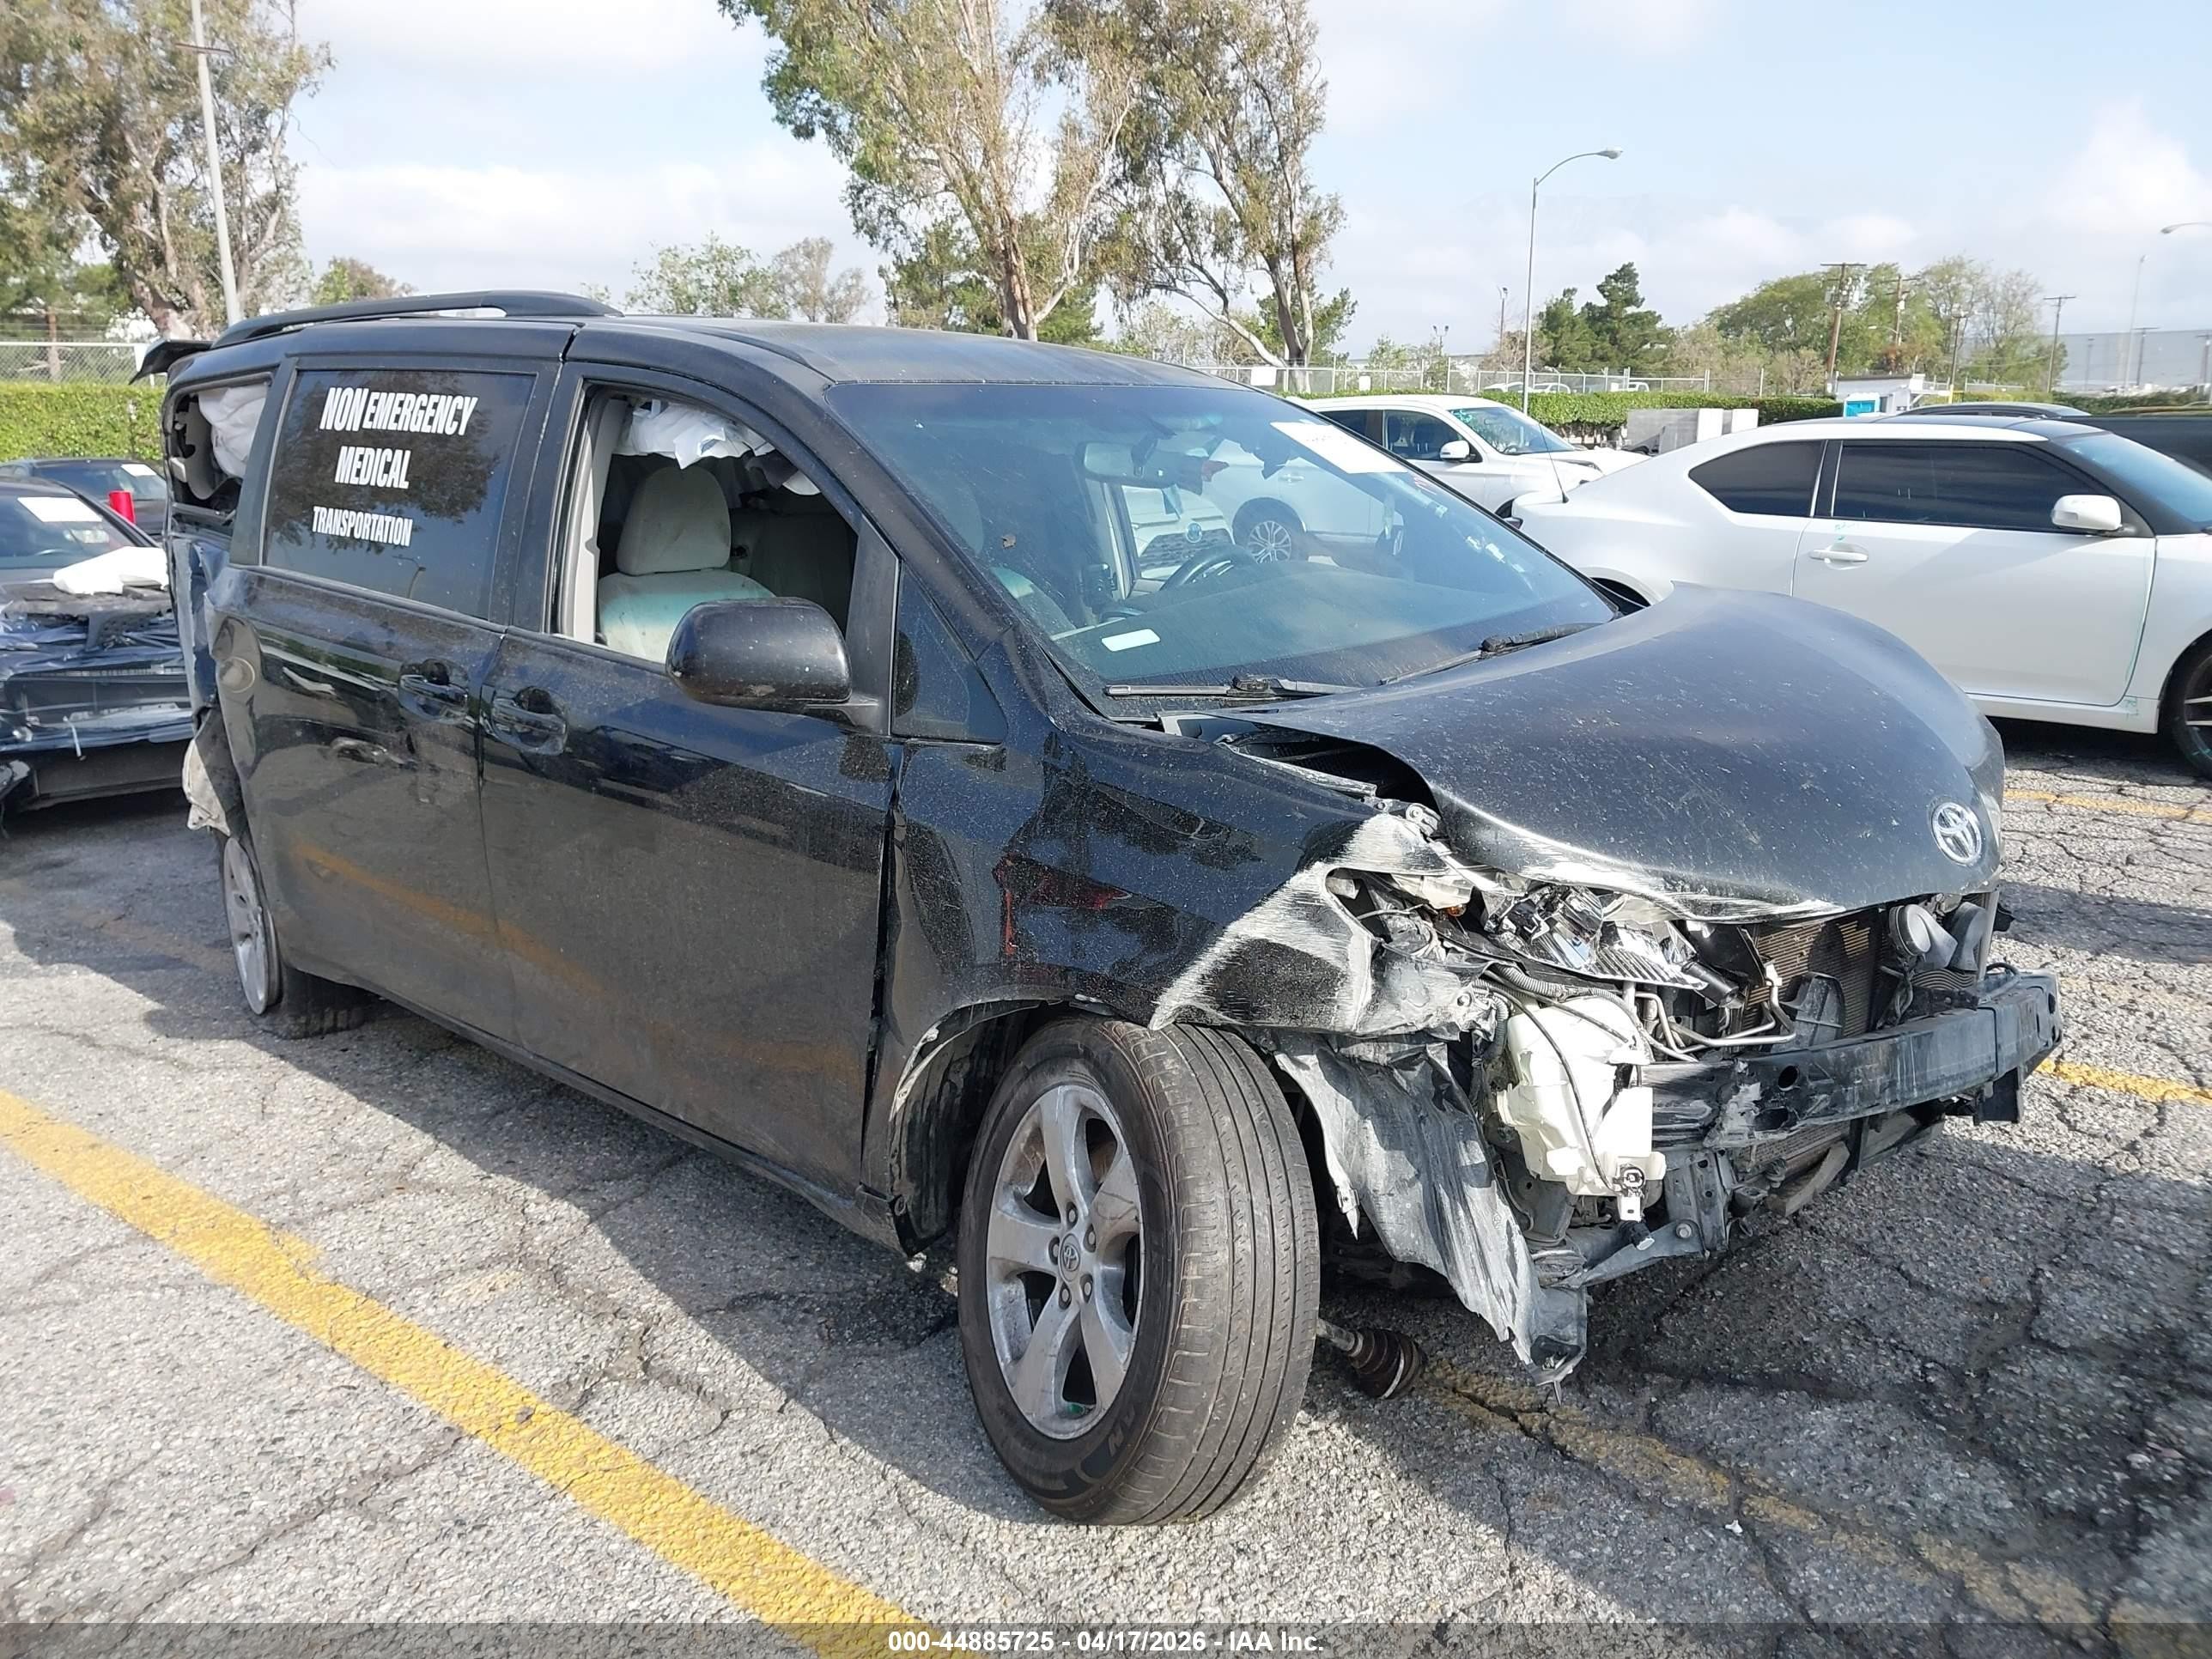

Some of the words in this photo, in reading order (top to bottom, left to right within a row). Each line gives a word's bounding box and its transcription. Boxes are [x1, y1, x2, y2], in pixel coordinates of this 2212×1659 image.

[319, 386, 369, 432] NON
[362, 392, 479, 436] EMERGENCY
[334, 446, 411, 489] MEDICAL
[312, 505, 413, 547] TRANSPORTATION
